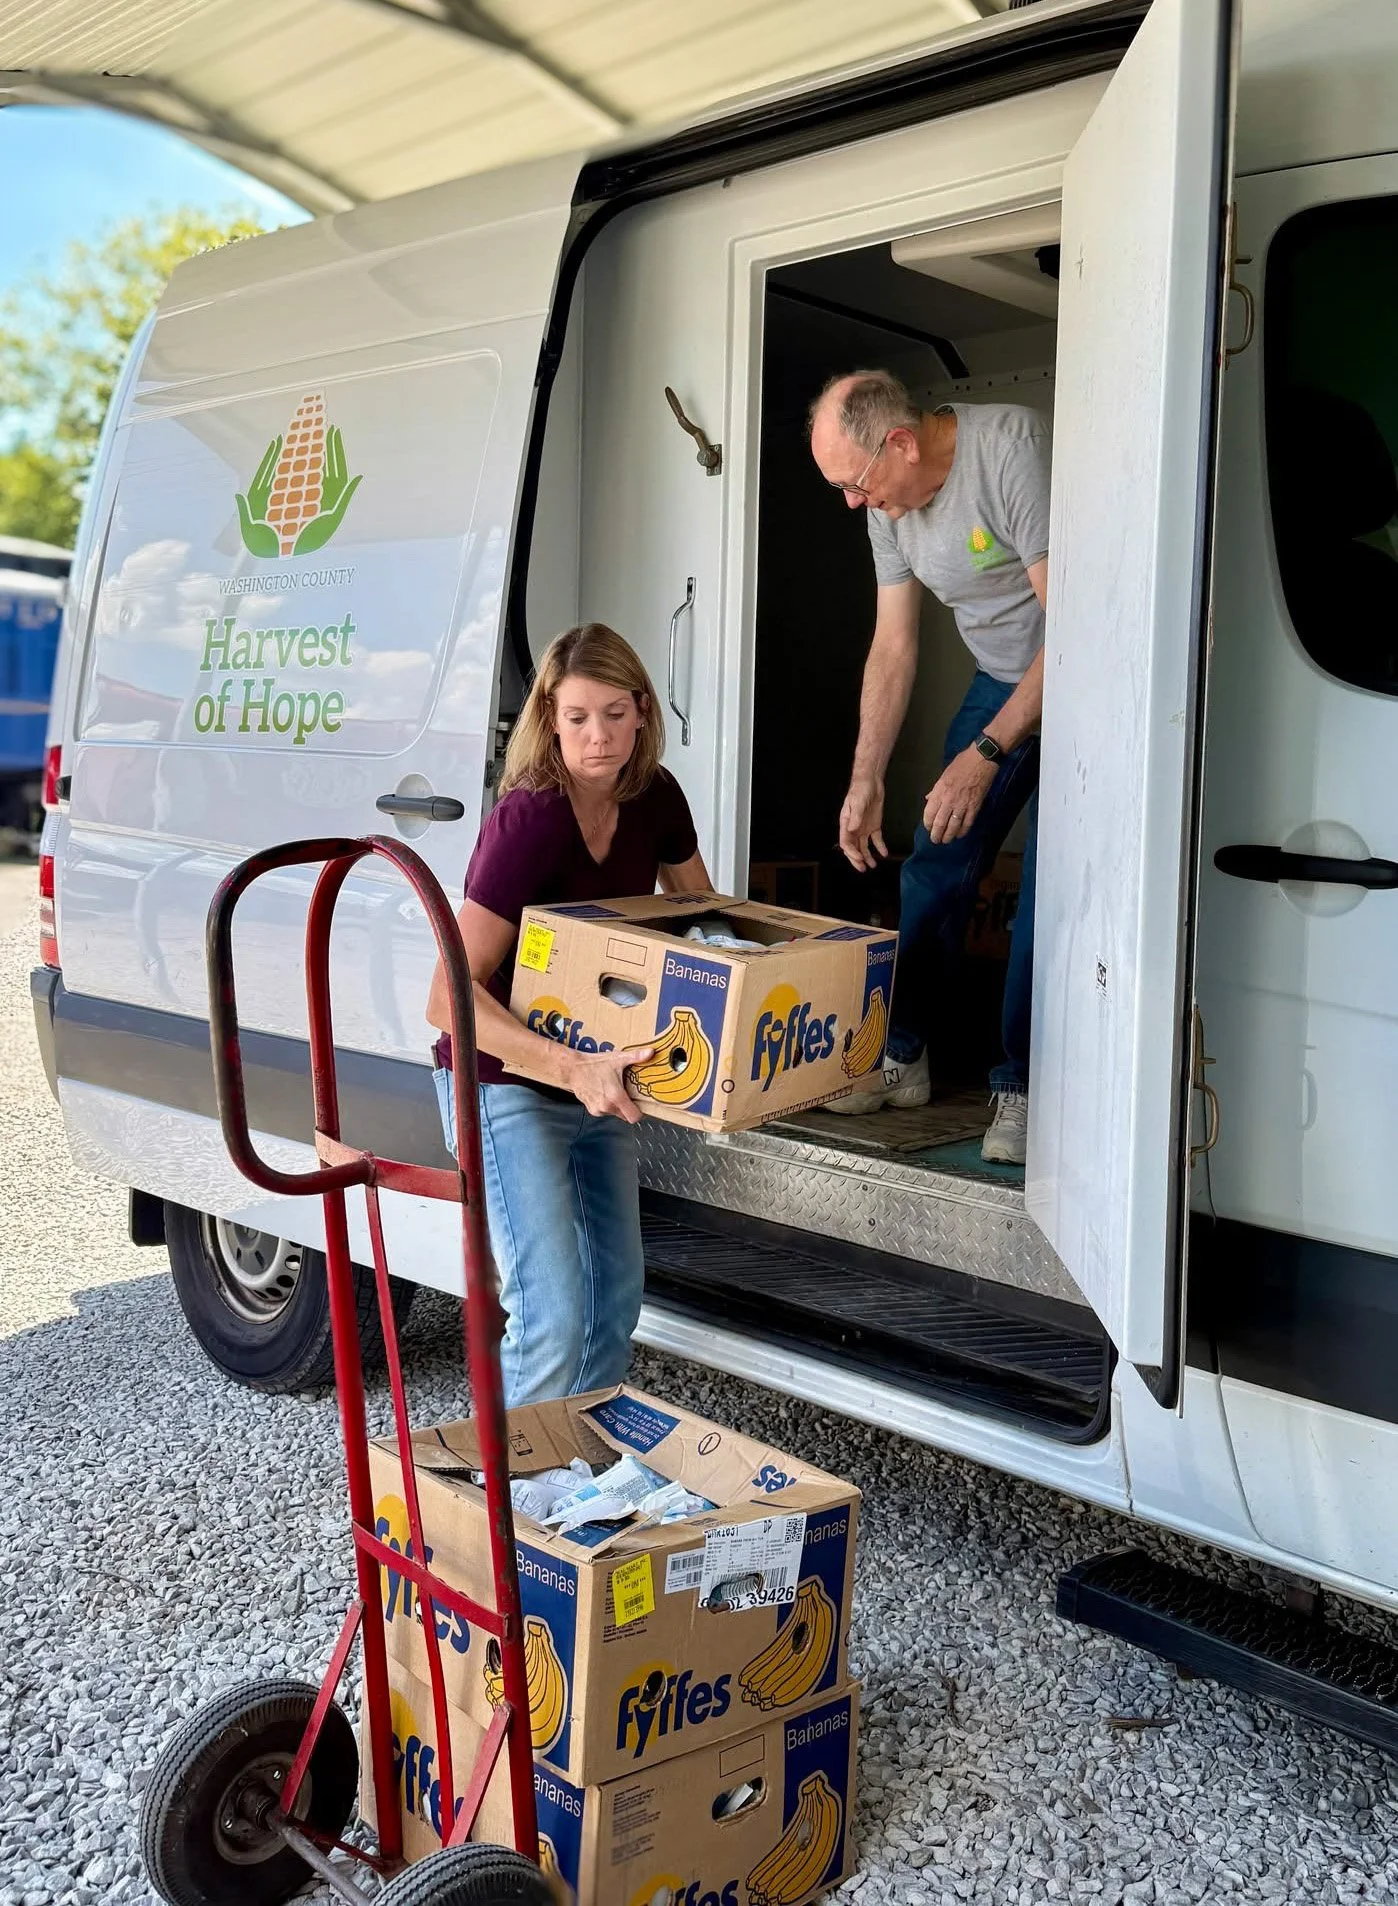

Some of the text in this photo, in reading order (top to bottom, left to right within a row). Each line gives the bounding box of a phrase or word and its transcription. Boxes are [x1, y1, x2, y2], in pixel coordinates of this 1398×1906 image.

[218, 568, 355, 595] WASHINGTON COUNTY
[200, 612, 356, 671] Harvest
[194, 678, 344, 745] of Hope
[868, 949, 896, 966] Bananas
[665, 958, 727, 989] Bananas
[751, 1002, 838, 1092] fyffes
[614, 1421, 631, 1436] With
[629, 1430, 654, 1447] Handle
[804, 1519, 847, 1546] nanas
[516, 1549, 575, 1596] Bananas
[746, 1586, 795, 1606] 39426
[787, 1710, 849, 1751] Bananas
[533, 1773, 582, 1818] ananas
